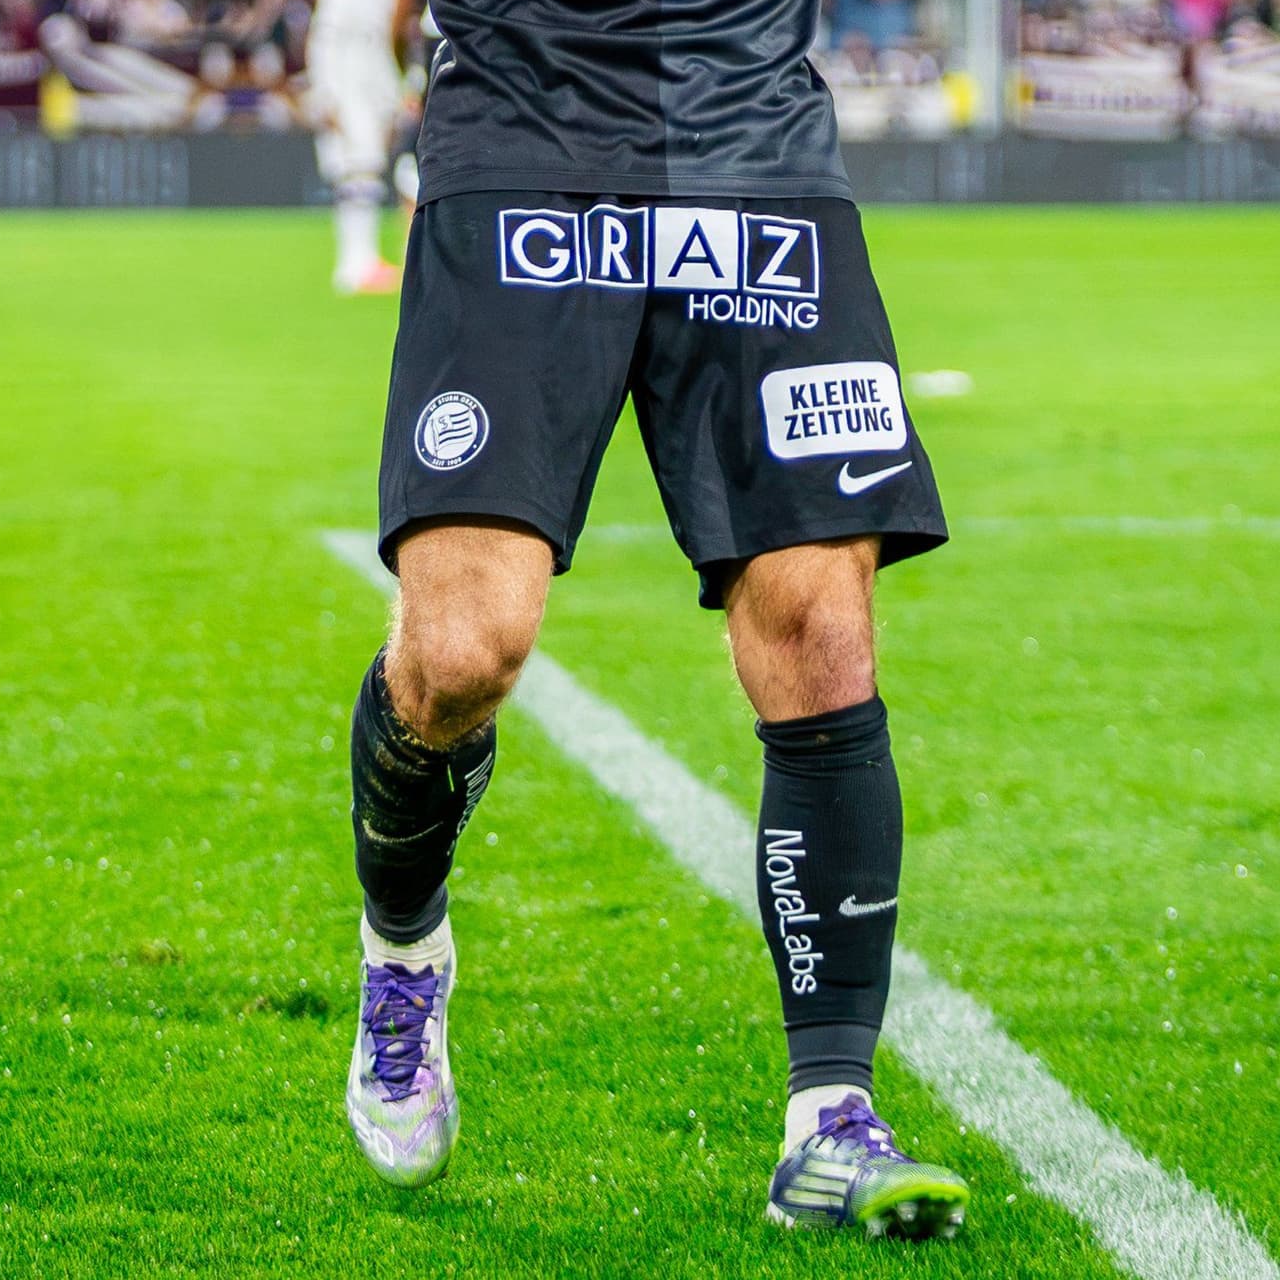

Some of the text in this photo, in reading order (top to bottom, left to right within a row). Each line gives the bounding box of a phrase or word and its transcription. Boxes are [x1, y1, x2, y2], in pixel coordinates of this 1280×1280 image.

[511, 215, 802, 288] GRAZ
[689, 293, 819, 330] HOLDING
[790, 378, 882, 411] KLEINE
[784, 407, 893, 442] ZEITUNG
[764, 828, 824, 995] NovaLabs
